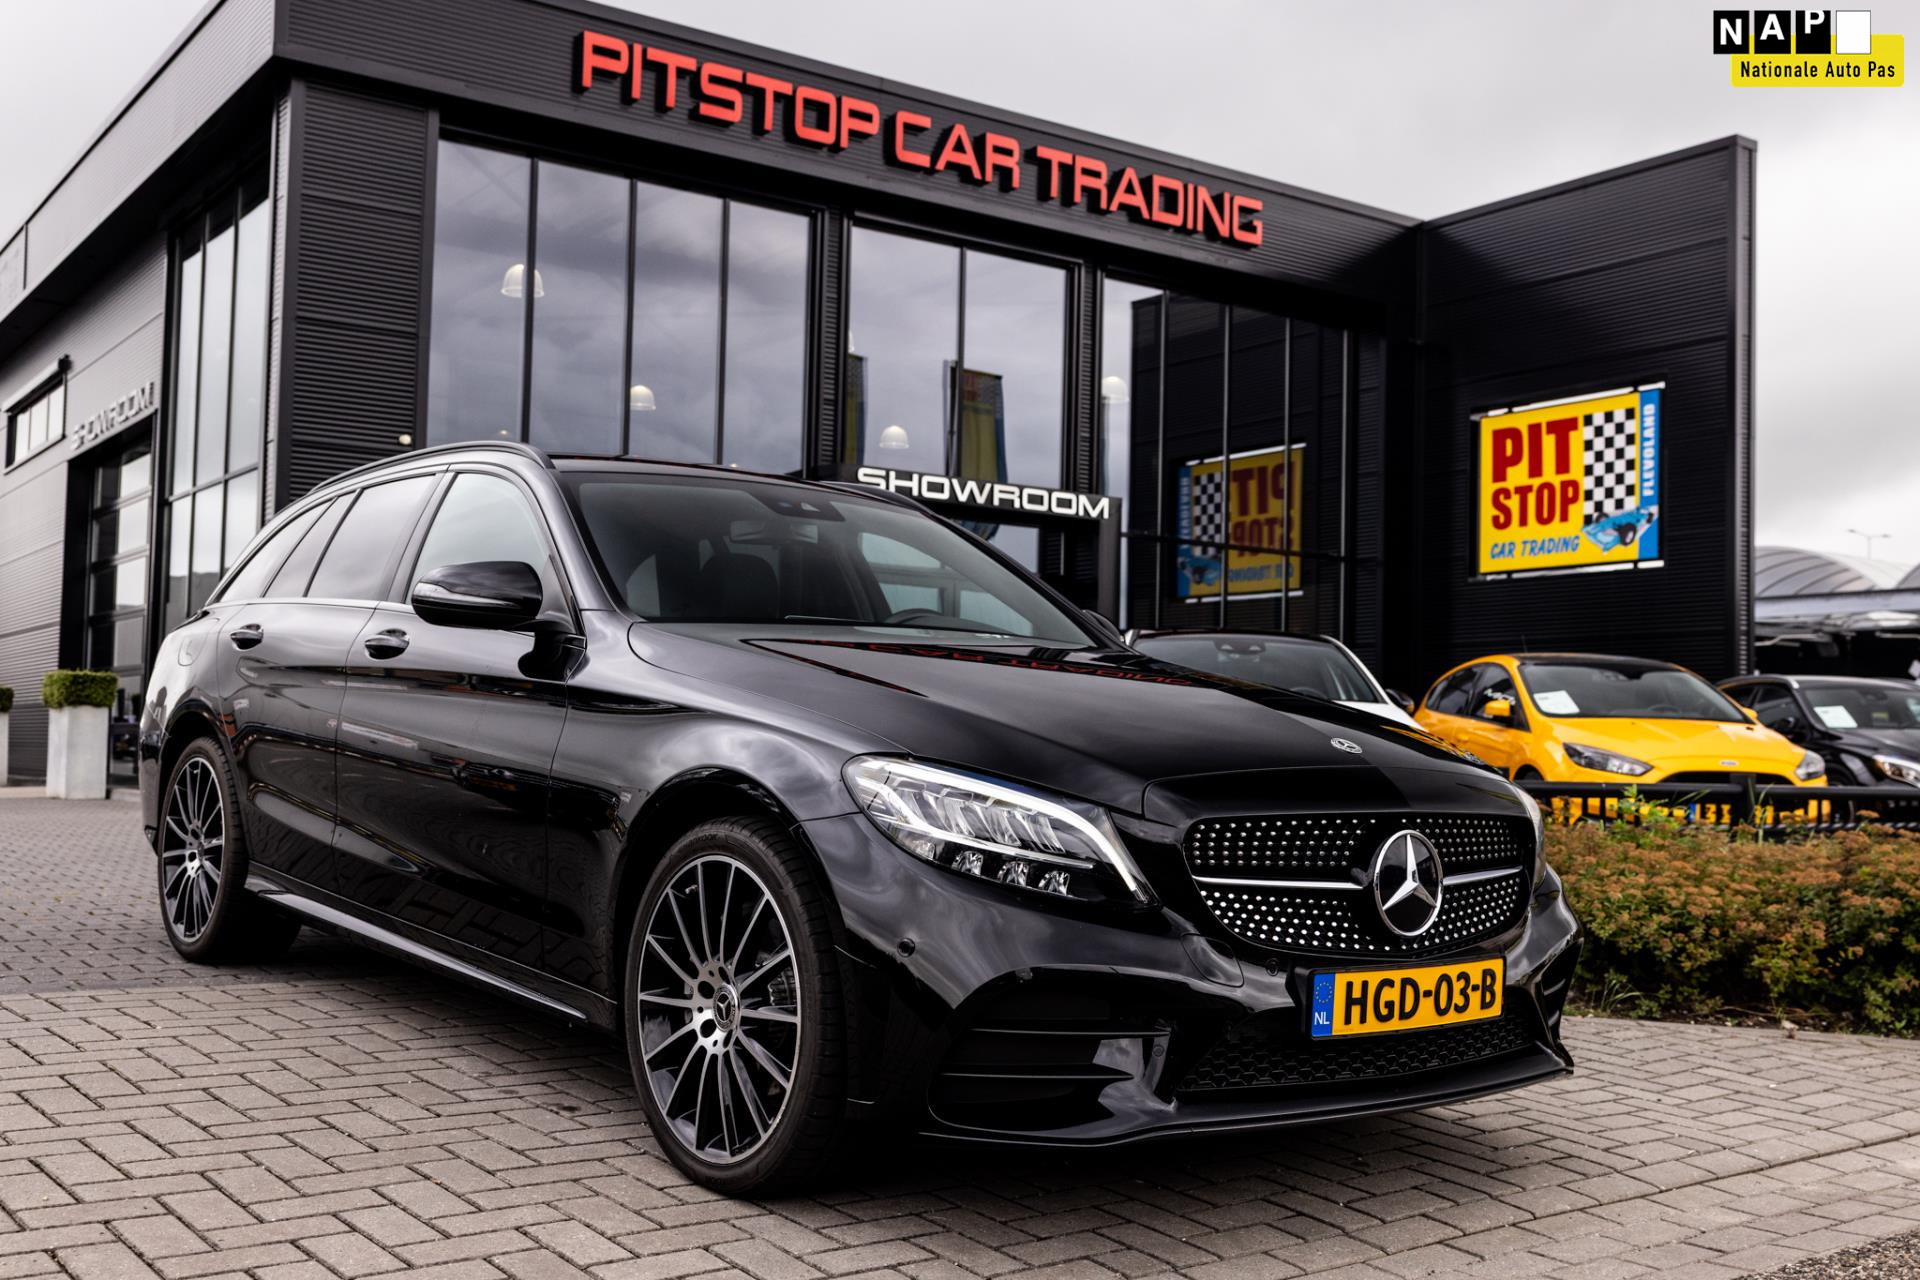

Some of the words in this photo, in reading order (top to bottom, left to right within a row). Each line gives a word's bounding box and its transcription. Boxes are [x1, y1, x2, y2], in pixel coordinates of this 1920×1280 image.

[581, 30, 880, 150] PITSTOP
[895, 110, 1021, 190] CAR
[1034, 146, 1264, 247] TRADING
[1491, 416, 1579, 484] PIT
[857, 466, 1110, 520] SHOWROOM
[1491, 479, 1580, 531] STOP
[1490, 541, 1516, 560] CAR
[1521, 535, 1581, 558] TRADING
[1313, 1011, 1330, 1026] NL
[1344, 968, 1497, 1026] HGD-03-B
